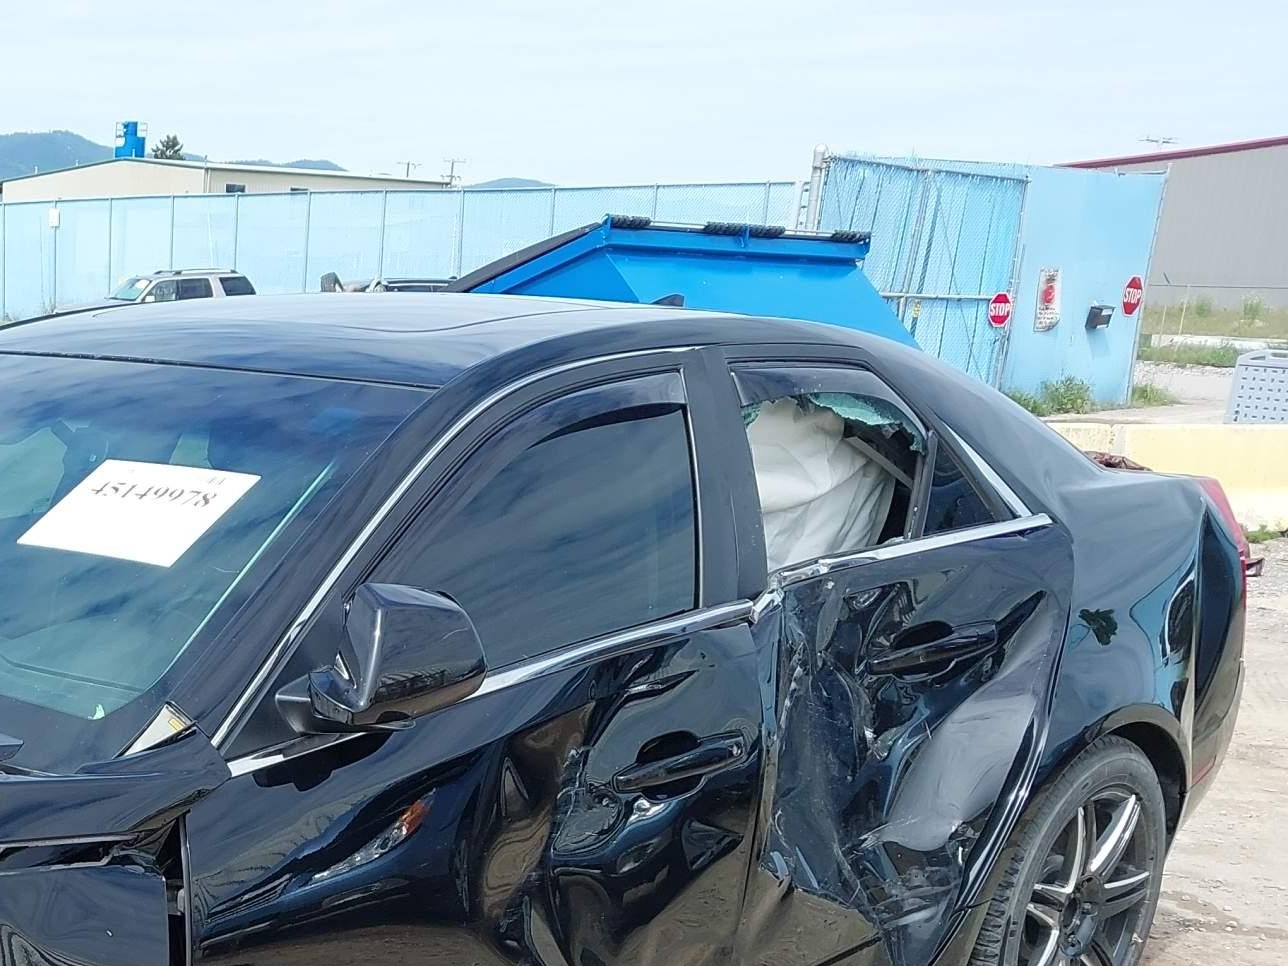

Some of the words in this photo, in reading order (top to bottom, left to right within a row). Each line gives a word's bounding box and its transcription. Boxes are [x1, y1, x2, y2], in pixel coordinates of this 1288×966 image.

[1123, 287, 1142, 304] STOP
[990, 302, 1011, 316] STOP
[90, 481, 218, 508] 45149978
